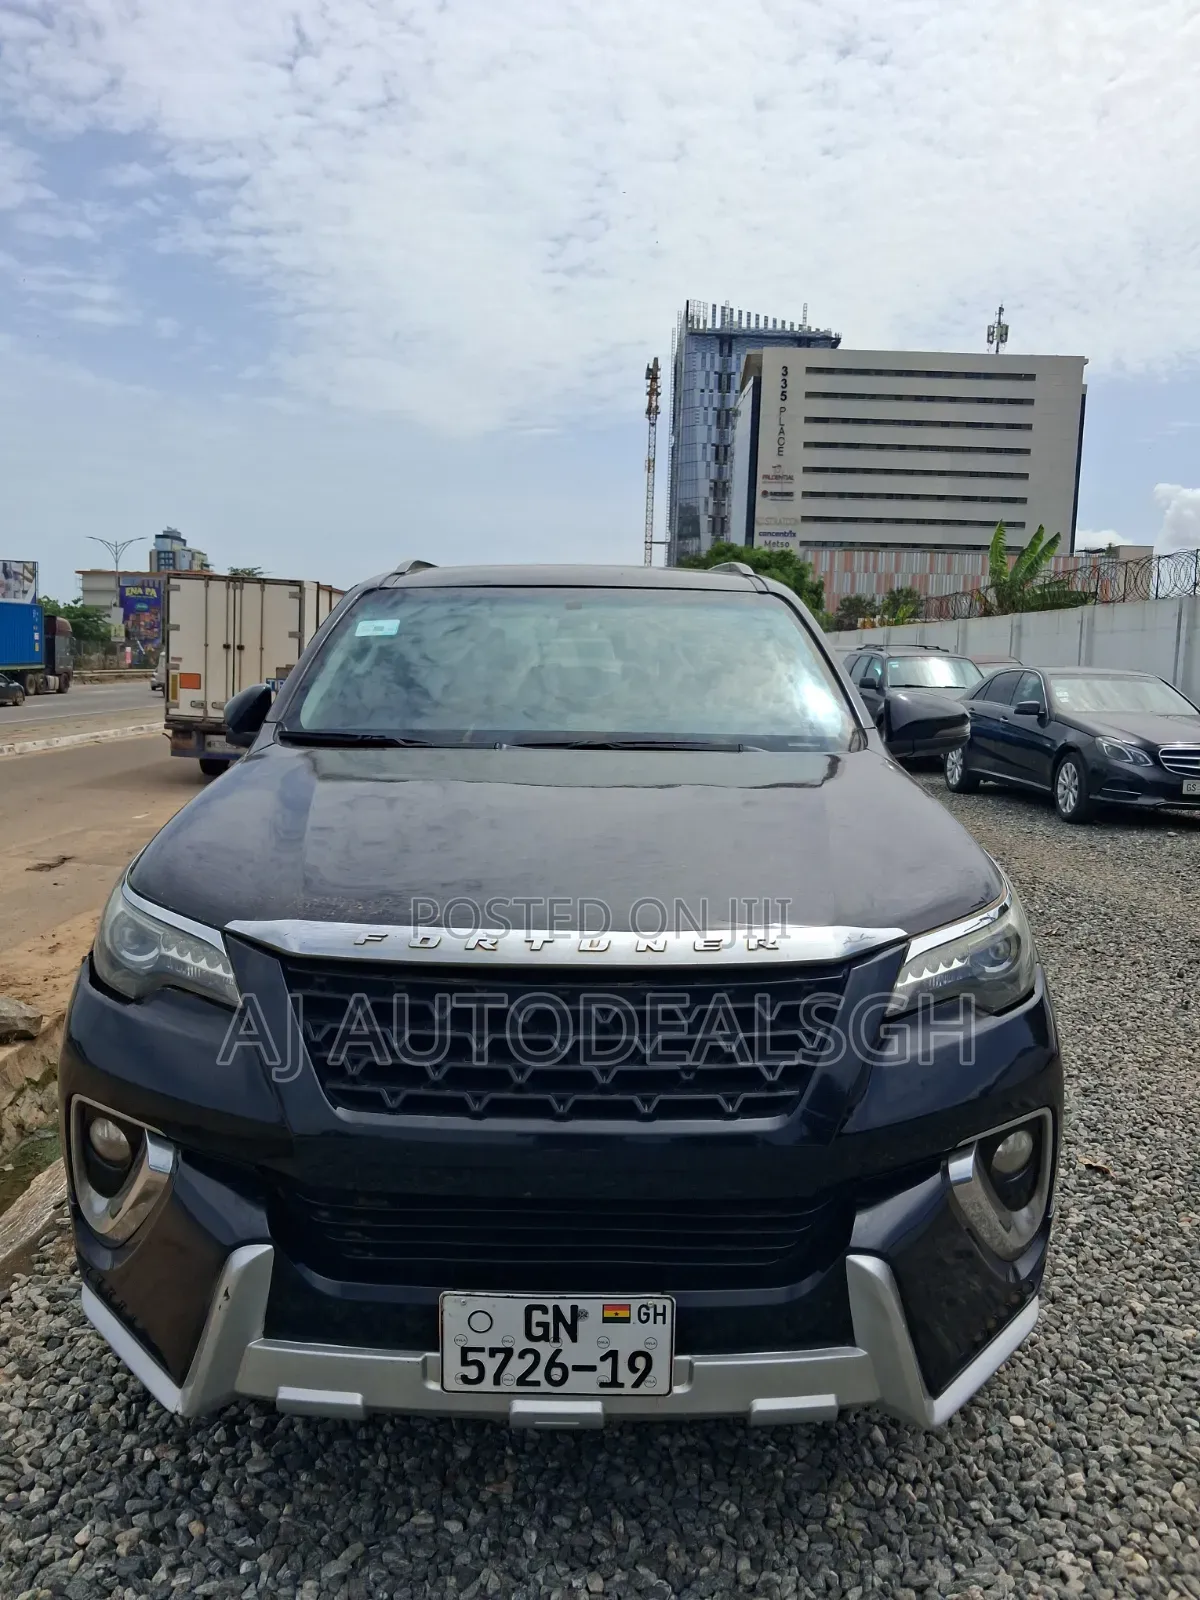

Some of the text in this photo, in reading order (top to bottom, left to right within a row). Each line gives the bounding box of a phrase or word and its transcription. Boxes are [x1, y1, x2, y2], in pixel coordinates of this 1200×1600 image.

[777, 366, 788, 457] 335 PLACE
[353, 932, 780, 952] FORTUNER
[524, 1304, 579, 1343] GN
[637, 1304, 667, 1325] GH
[460, 1347, 653, 1389] 5726-19
